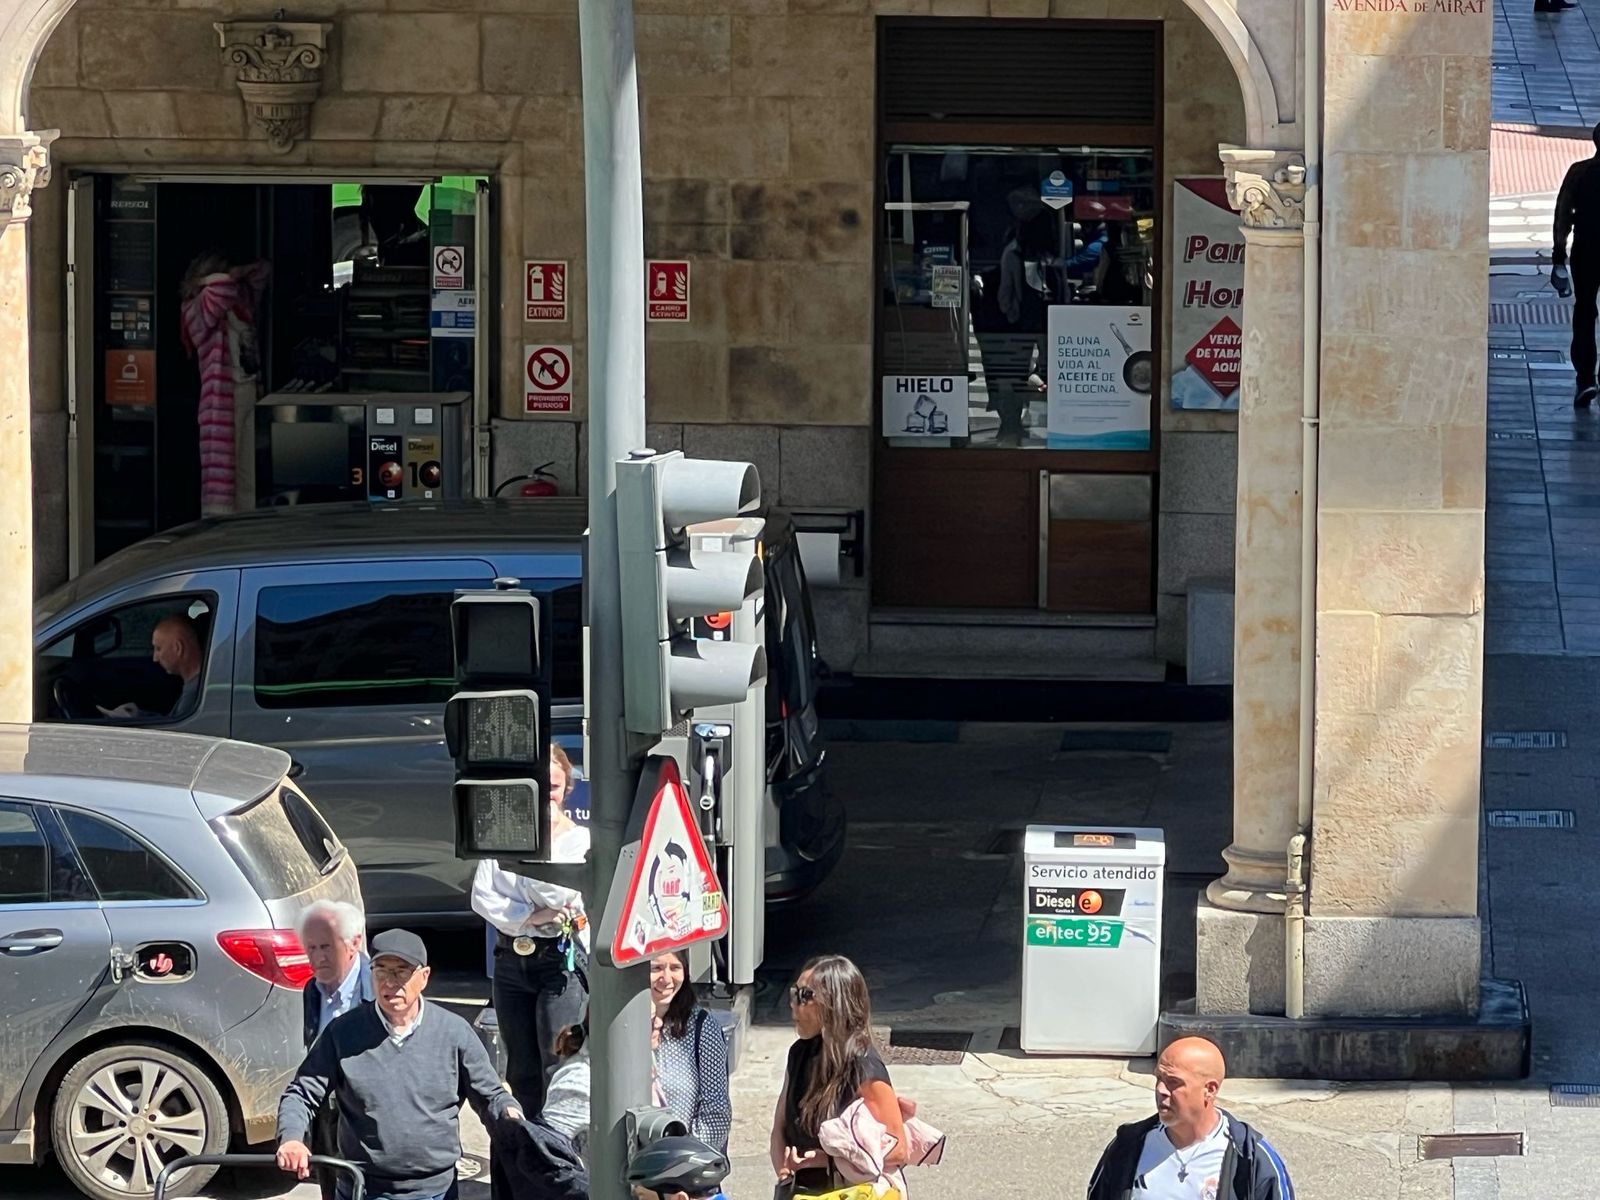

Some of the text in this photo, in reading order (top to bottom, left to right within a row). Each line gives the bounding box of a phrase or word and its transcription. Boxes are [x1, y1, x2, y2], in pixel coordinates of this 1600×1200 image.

[1333, 0, 1486, 15] AVENIDA DE MIRAT
[528, 307, 563, 318] EXTINTOR
[1058, 336, 1101, 345] DA UNA
[1058, 348, 1111, 358] SEGUNDA
[1196, 348, 1211, 358] DE
[1058, 360, 1102, 369] VIDA AL
[1058, 372, 1115, 381] ACEITE DE
[896, 378, 953, 393] HIELO
[1058, 384, 1072, 393] TU
[371, 442, 397, 451] Diesel
[408, 442, 434, 451] Diesel
[351, 467, 363, 485] 3
[575, 808, 590, 820] tu
[1032, 865, 1156, 880] Servicio atendido
[1036, 895, 1075, 908] Diesel
[1088, 924, 1111, 942] 95
